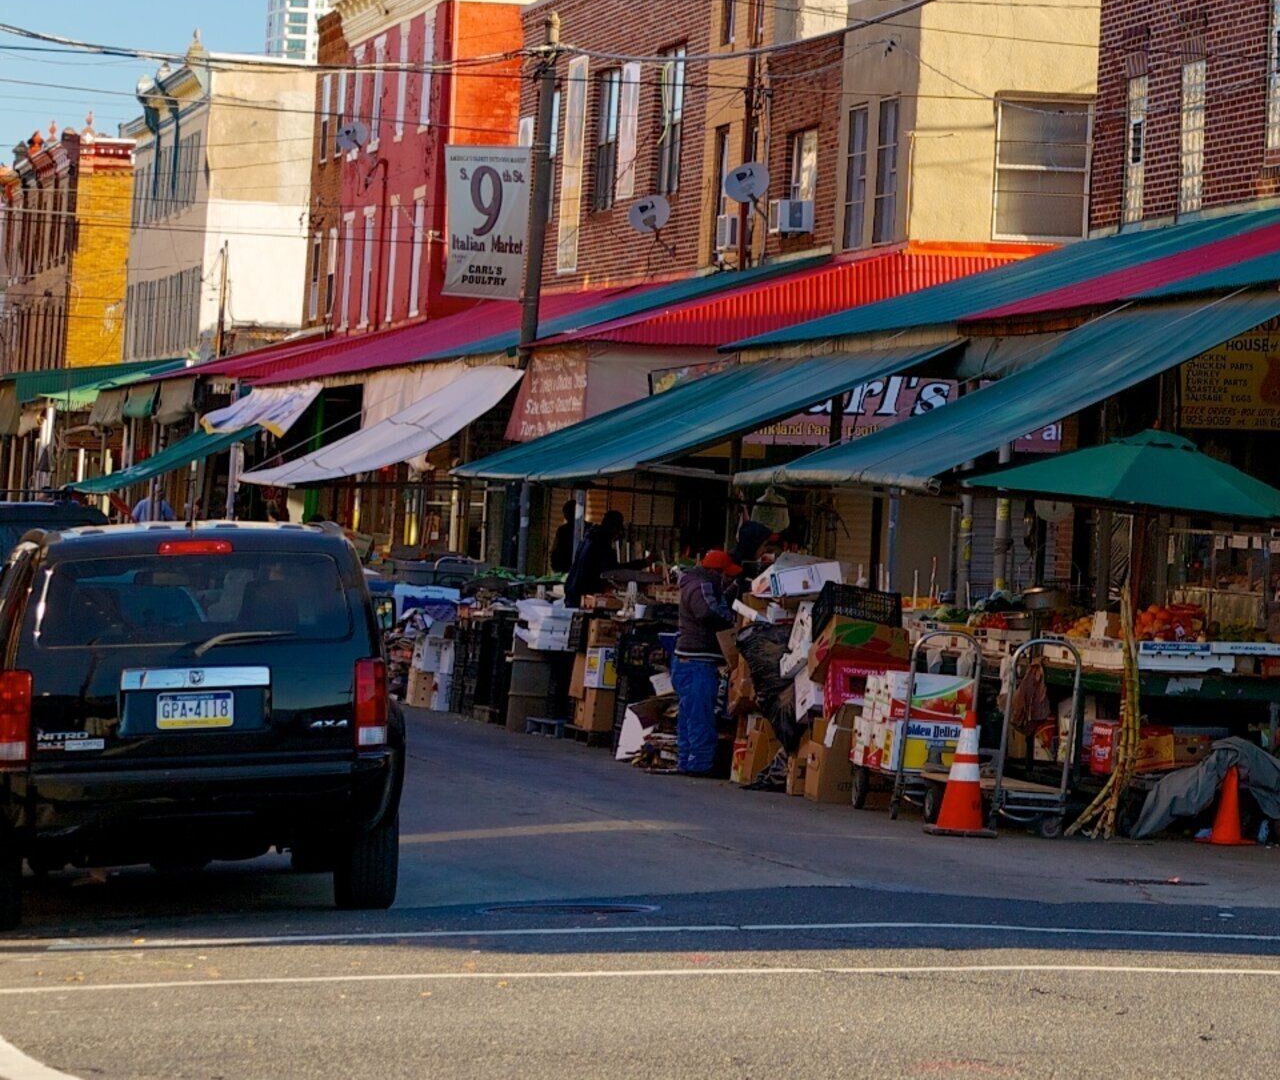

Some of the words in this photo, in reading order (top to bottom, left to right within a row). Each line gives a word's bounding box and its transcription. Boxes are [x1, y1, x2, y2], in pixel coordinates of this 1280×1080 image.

[452, 233, 485, 253] Italian
[491, 235, 523, 255] Market
[468, 264, 503, 276] CARL'S
[461, 275, 507, 286] POULTRY
[1226, 339, 1269, 352] HOUSE
[1186, 361, 1226, 370] CHICKEN
[1231, 363, 1254, 371] PARTS
[1224, 379, 1248, 387] PARTS
[37, 729, 89, 741] NITRO
[933, 725, 961, 738] Delici
